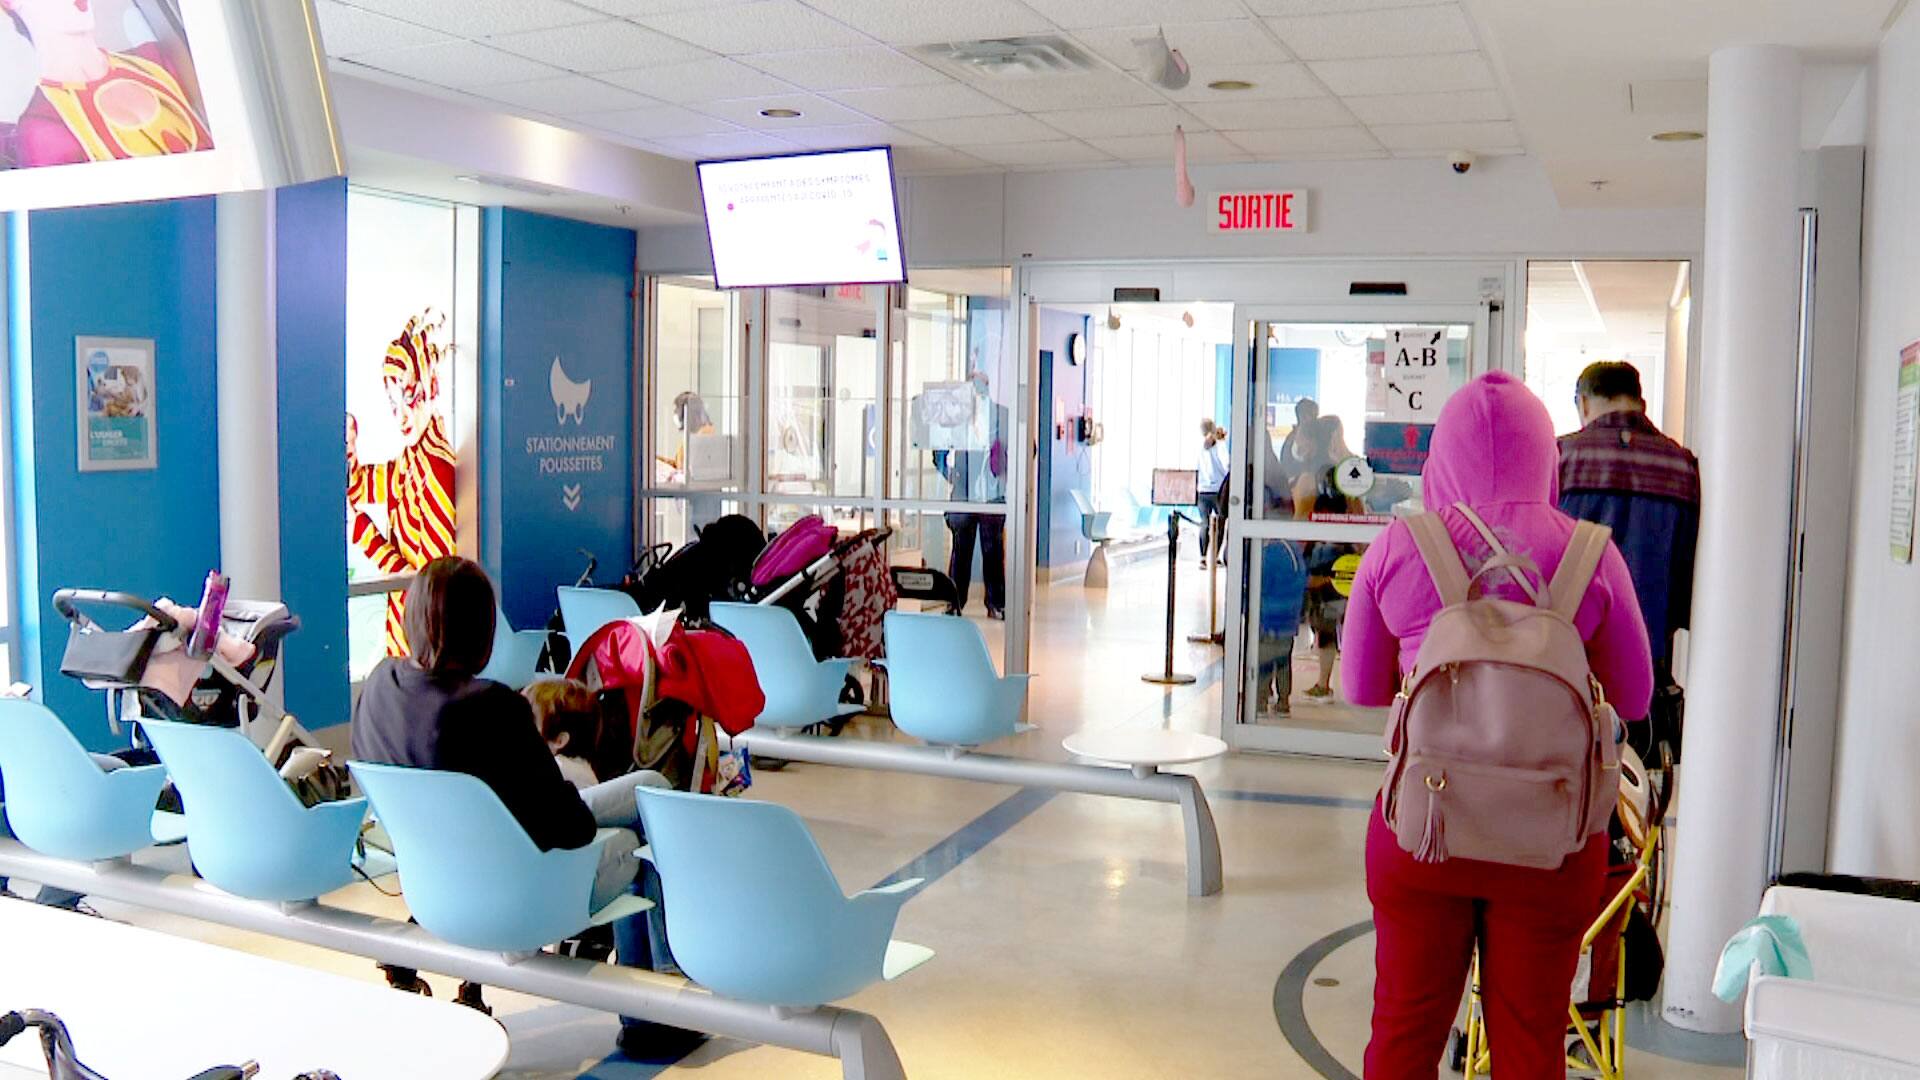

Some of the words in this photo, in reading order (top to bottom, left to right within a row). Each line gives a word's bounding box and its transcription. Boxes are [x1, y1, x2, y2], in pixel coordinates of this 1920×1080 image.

[1218, 194, 1294, 229] SORTIE
[1395, 347, 1437, 367] A-B
[1408, 391, 1422, 410] C
[526, 435, 615, 453] STATIONNEMENT
[540, 456, 604, 473] POUSSETTES
